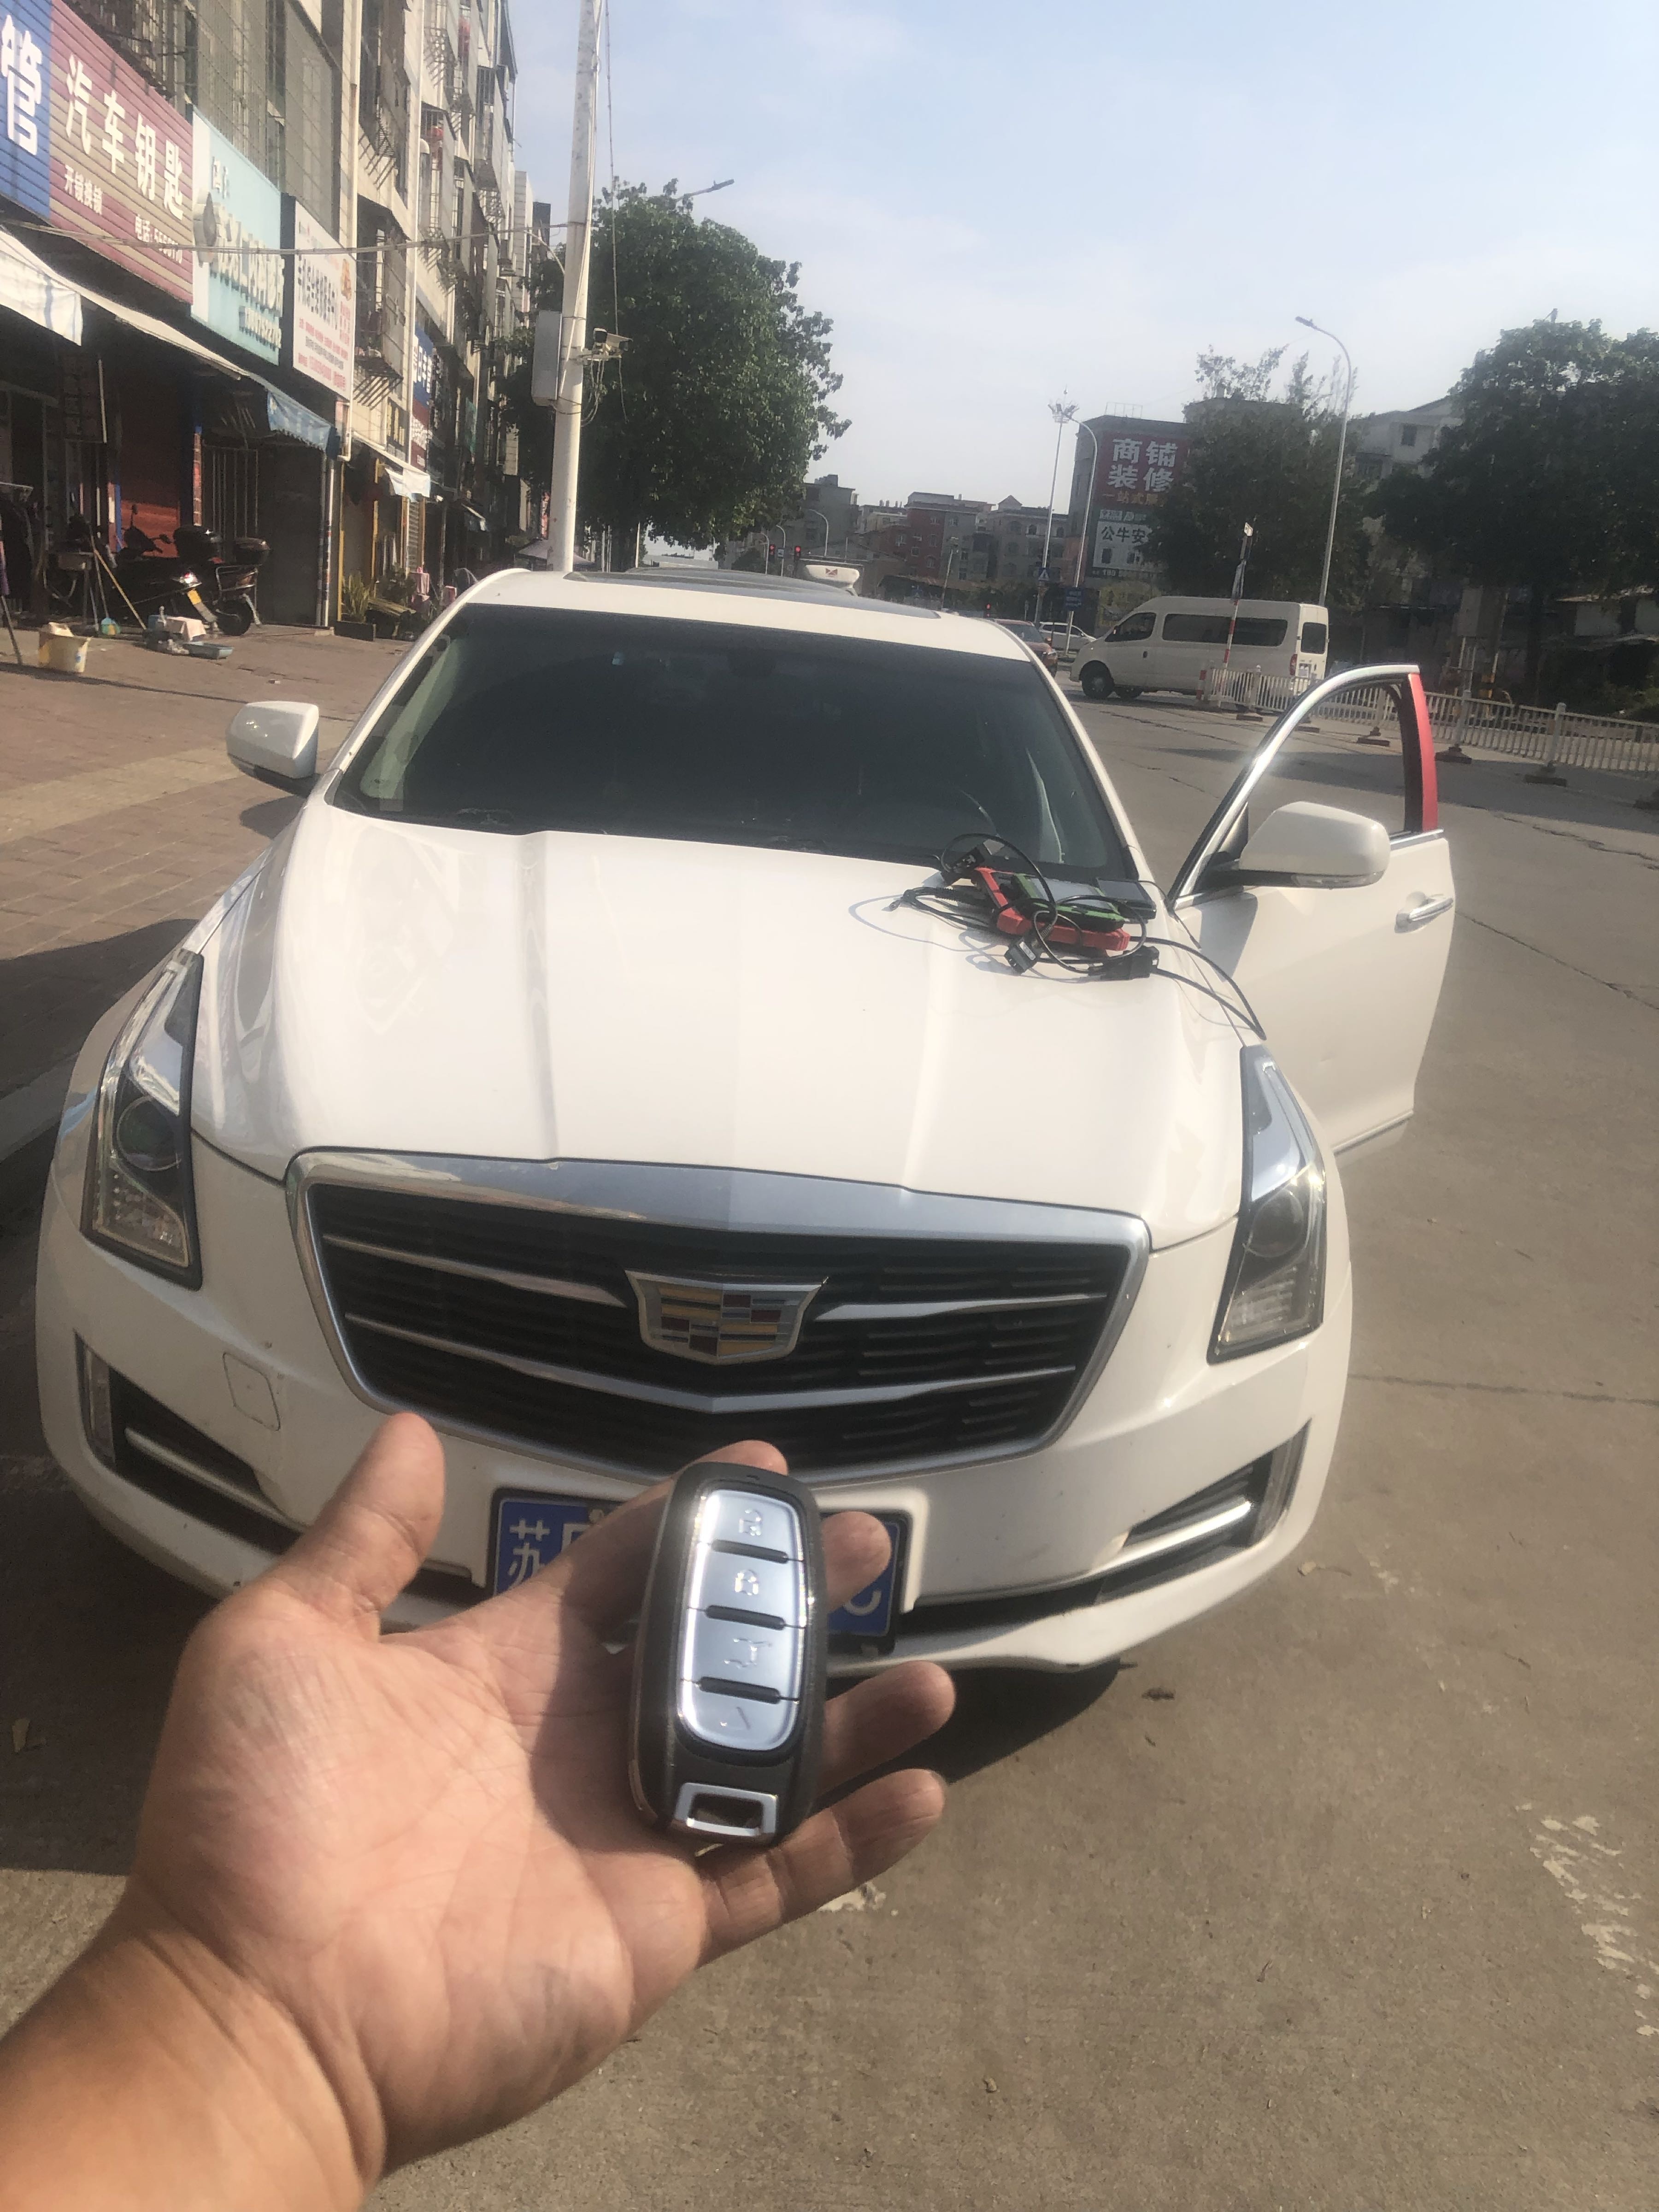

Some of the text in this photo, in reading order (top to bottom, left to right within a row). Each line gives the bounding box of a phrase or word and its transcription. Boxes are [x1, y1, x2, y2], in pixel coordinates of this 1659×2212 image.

[66, 53, 183, 220] 汽车钥匙
[1112, 438, 1178, 468] 商铺
[1107, 464, 1175, 493] 装修
